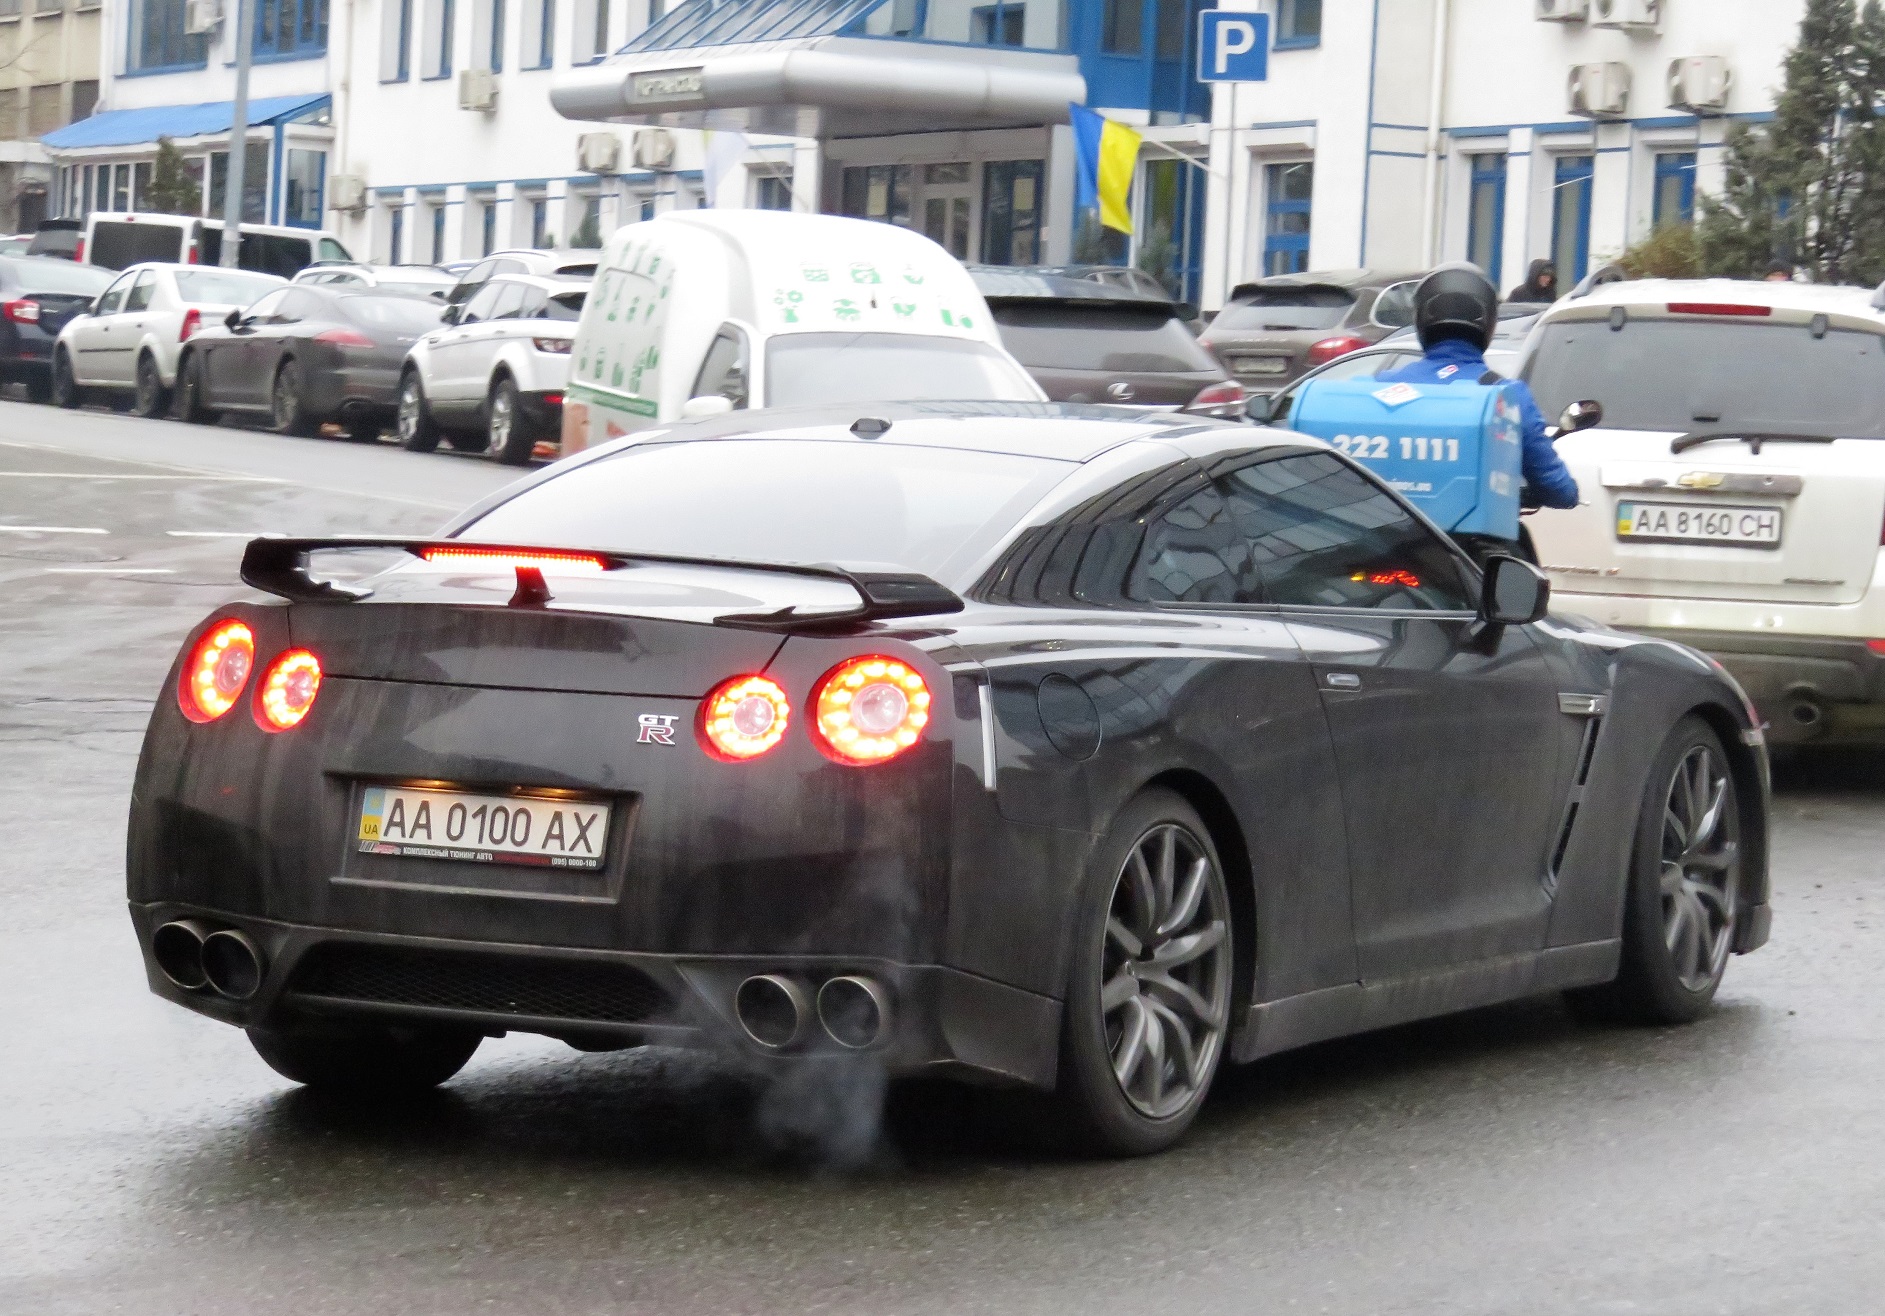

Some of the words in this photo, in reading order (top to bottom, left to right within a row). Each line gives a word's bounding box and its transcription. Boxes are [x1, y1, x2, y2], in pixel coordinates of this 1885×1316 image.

[1215, 20, 1255, 74] P
[1332, 434, 1390, 459] 222
[1399, 436, 1459, 461] 1111
[1635, 509, 1669, 533] AA
[1677, 511, 1732, 536] 8160
[1739, 514, 1775, 538] CH
[363, 823, 379, 835] UA
[383, 798, 433, 840] AA
[446, 802, 532, 848] 0100
[541, 810, 598, 854] AX
[403, 846, 449, 858] КОМПЛЕКСНЫЙ
[450, 850, 476, 860] ТЮНИНГ
[476, 852, 493, 861] АВТО
